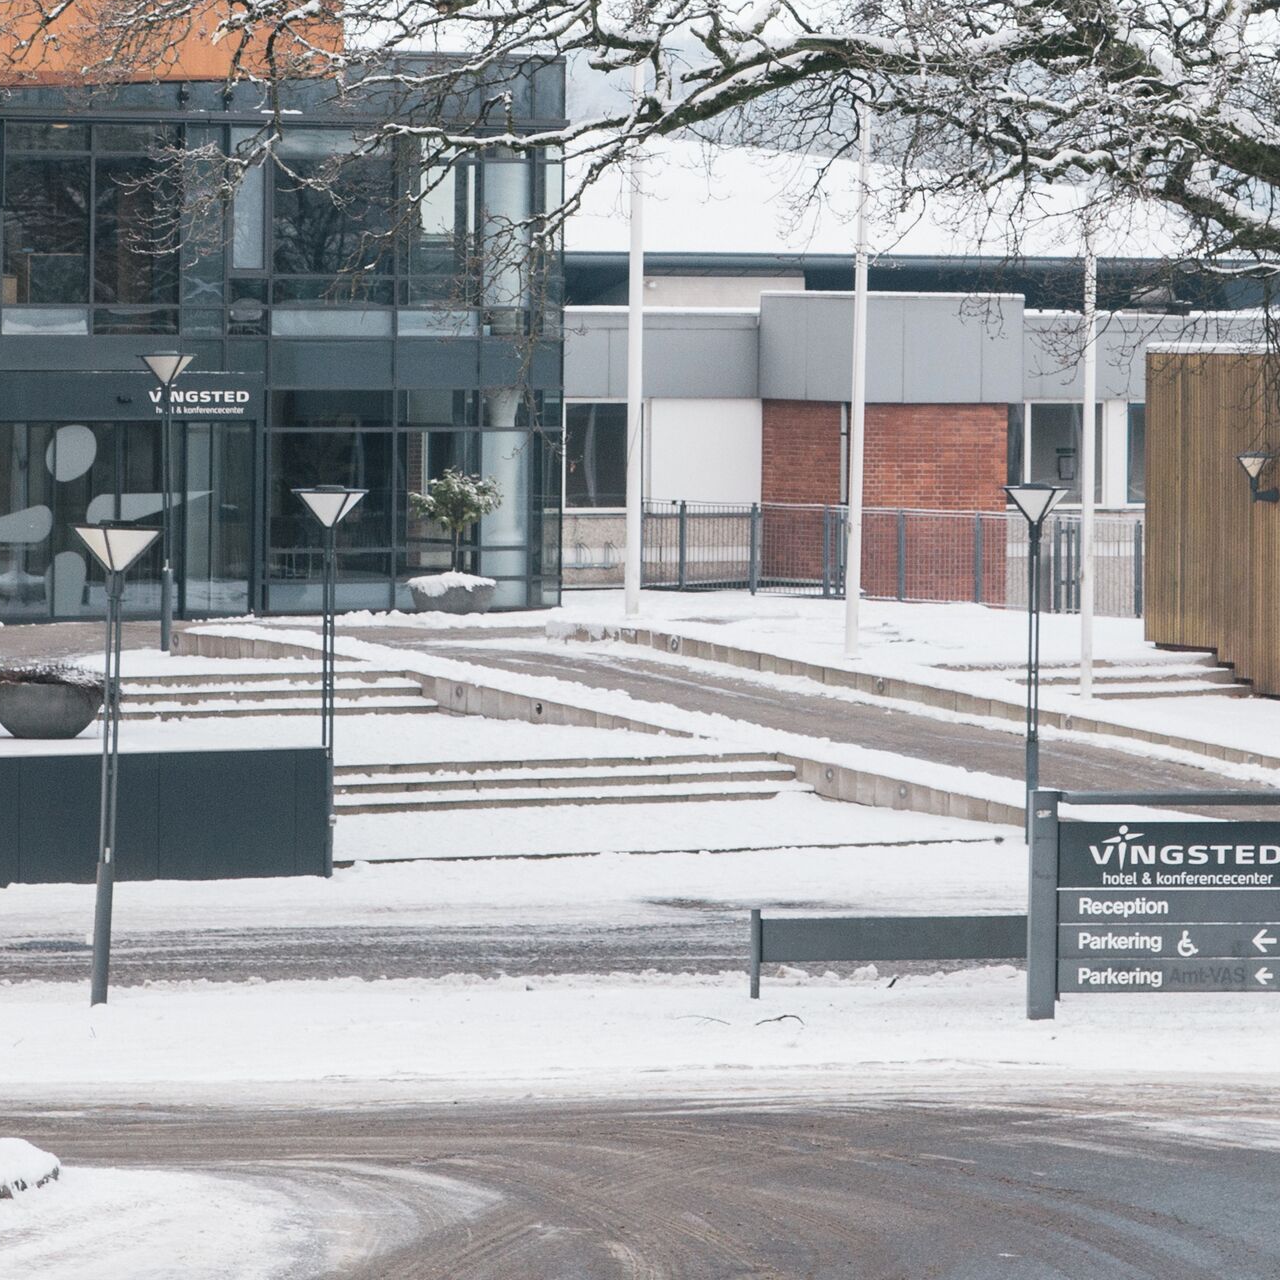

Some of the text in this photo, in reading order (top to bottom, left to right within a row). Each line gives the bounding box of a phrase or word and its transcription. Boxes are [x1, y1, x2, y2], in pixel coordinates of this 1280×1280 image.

[148, 388, 250, 403] VNGSTED
[176, 406, 183, 415] &
[183, 406, 245, 415] konferencecenter
[1102, 871, 1274, 886] hotel & konferencecenter
[1078, 897, 1169, 918] Reception
[1078, 931, 1163, 953] Parkering
[1077, 967, 1163, 988] Parkering
